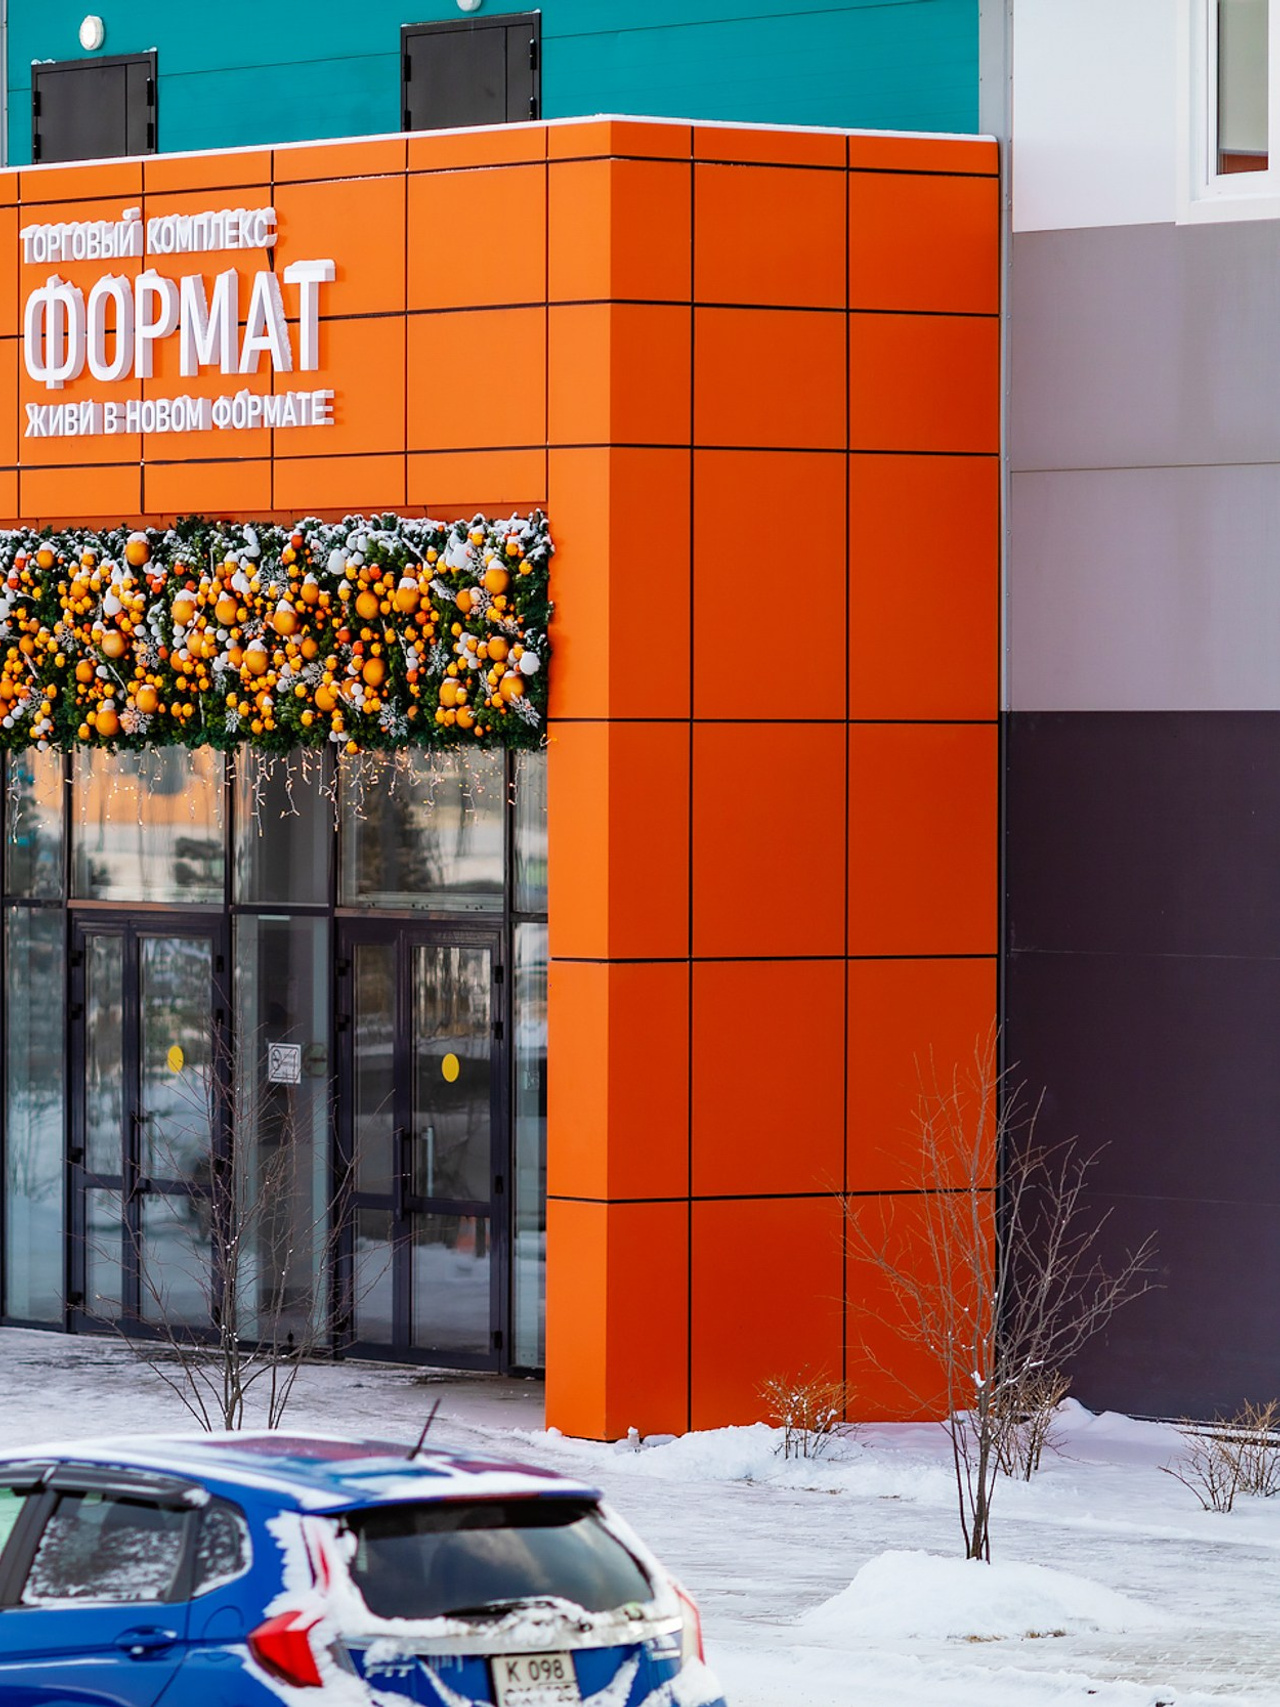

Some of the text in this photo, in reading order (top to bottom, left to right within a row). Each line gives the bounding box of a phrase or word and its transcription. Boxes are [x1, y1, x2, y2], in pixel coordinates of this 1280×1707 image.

[19, 207, 278, 264] ТОРГОВЫЙ КОМПЛЕКС
[23, 260, 336, 389] ФОРМАТ
[24, 389, 334, 438] ЖИВИ В НОВОМ ФОРМАТЕ
[528, 1658, 565, 1682] 098
